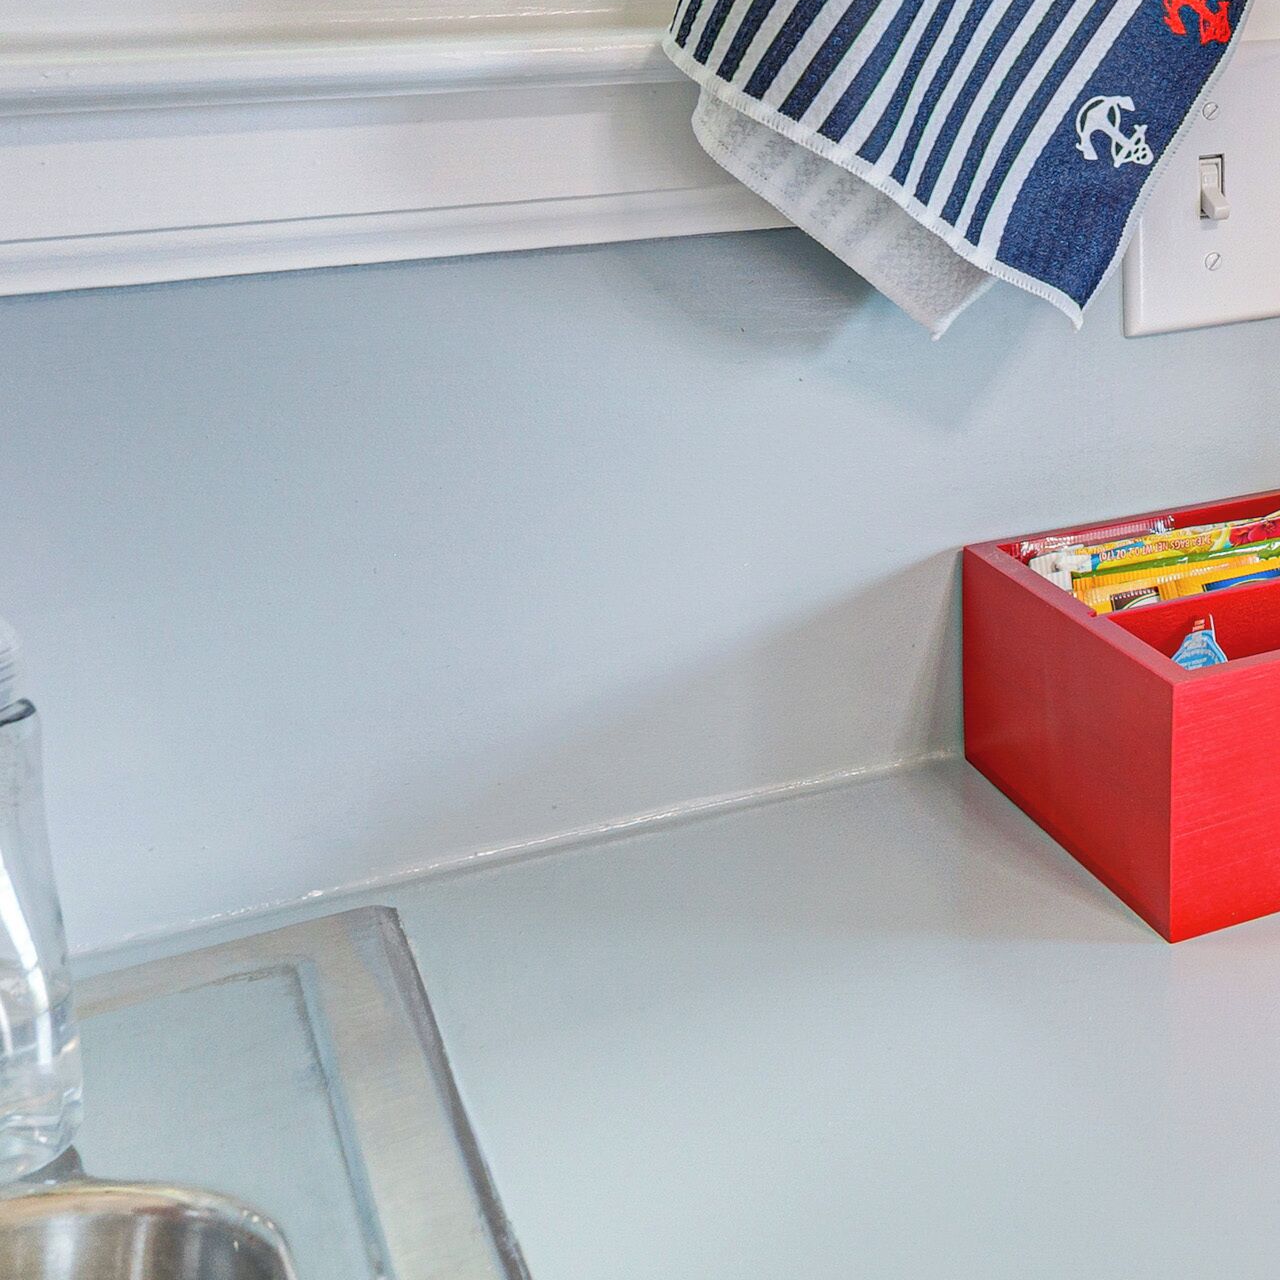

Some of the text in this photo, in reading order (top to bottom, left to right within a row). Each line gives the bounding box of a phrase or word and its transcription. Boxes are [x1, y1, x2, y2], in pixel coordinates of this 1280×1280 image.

[1142, 544, 1153, 555] WT
[1154, 541, 1168, 552] NET
[1171, 538, 1190, 550] BAGS
[1116, 549, 1126, 560] OZ
